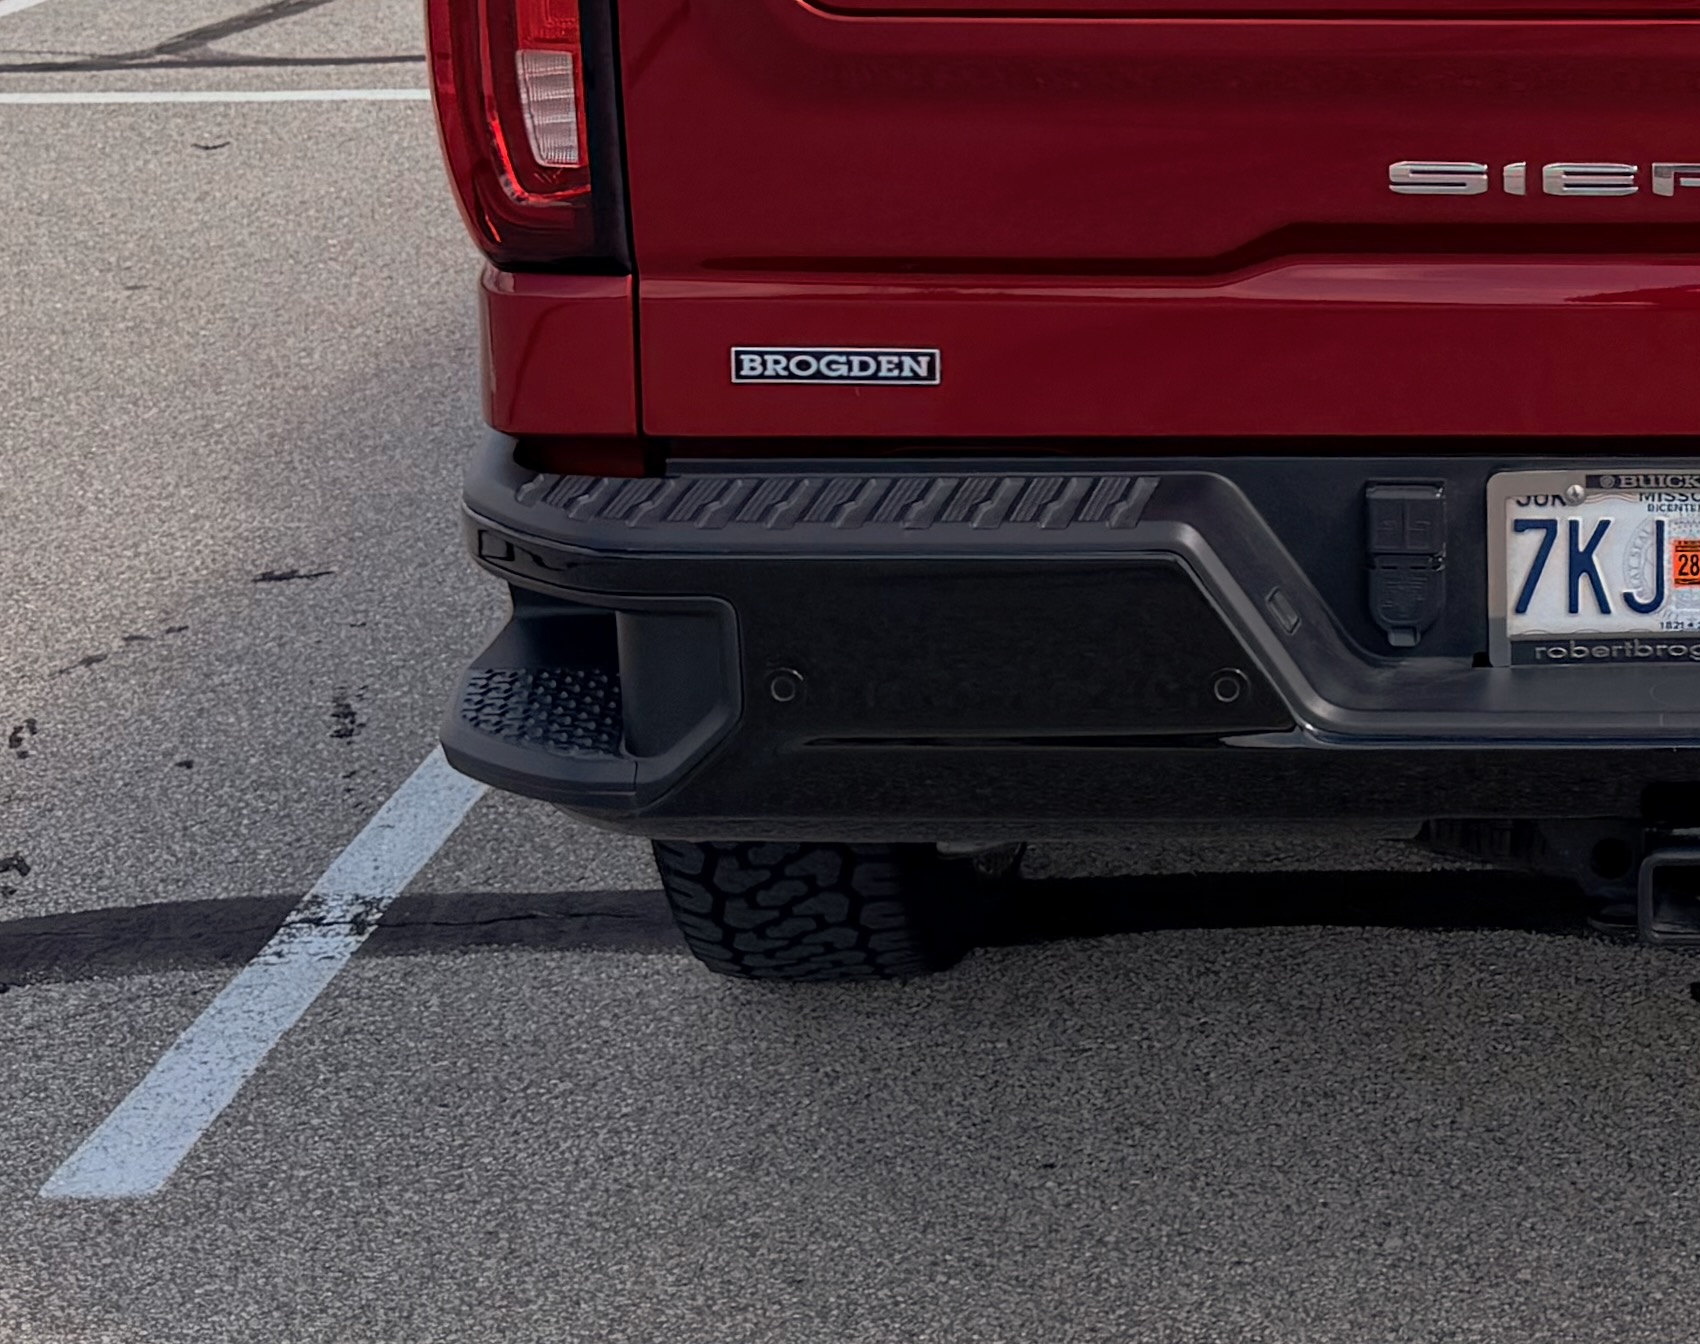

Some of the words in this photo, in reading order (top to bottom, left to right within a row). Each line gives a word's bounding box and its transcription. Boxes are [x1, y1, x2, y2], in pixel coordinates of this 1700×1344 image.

[739, 354, 931, 377] BROGDEN
[1513, 519, 1665, 614] 7KJ
[1677, 553, 1700, 576] 28
[1660, 621, 1685, 630] 1821
